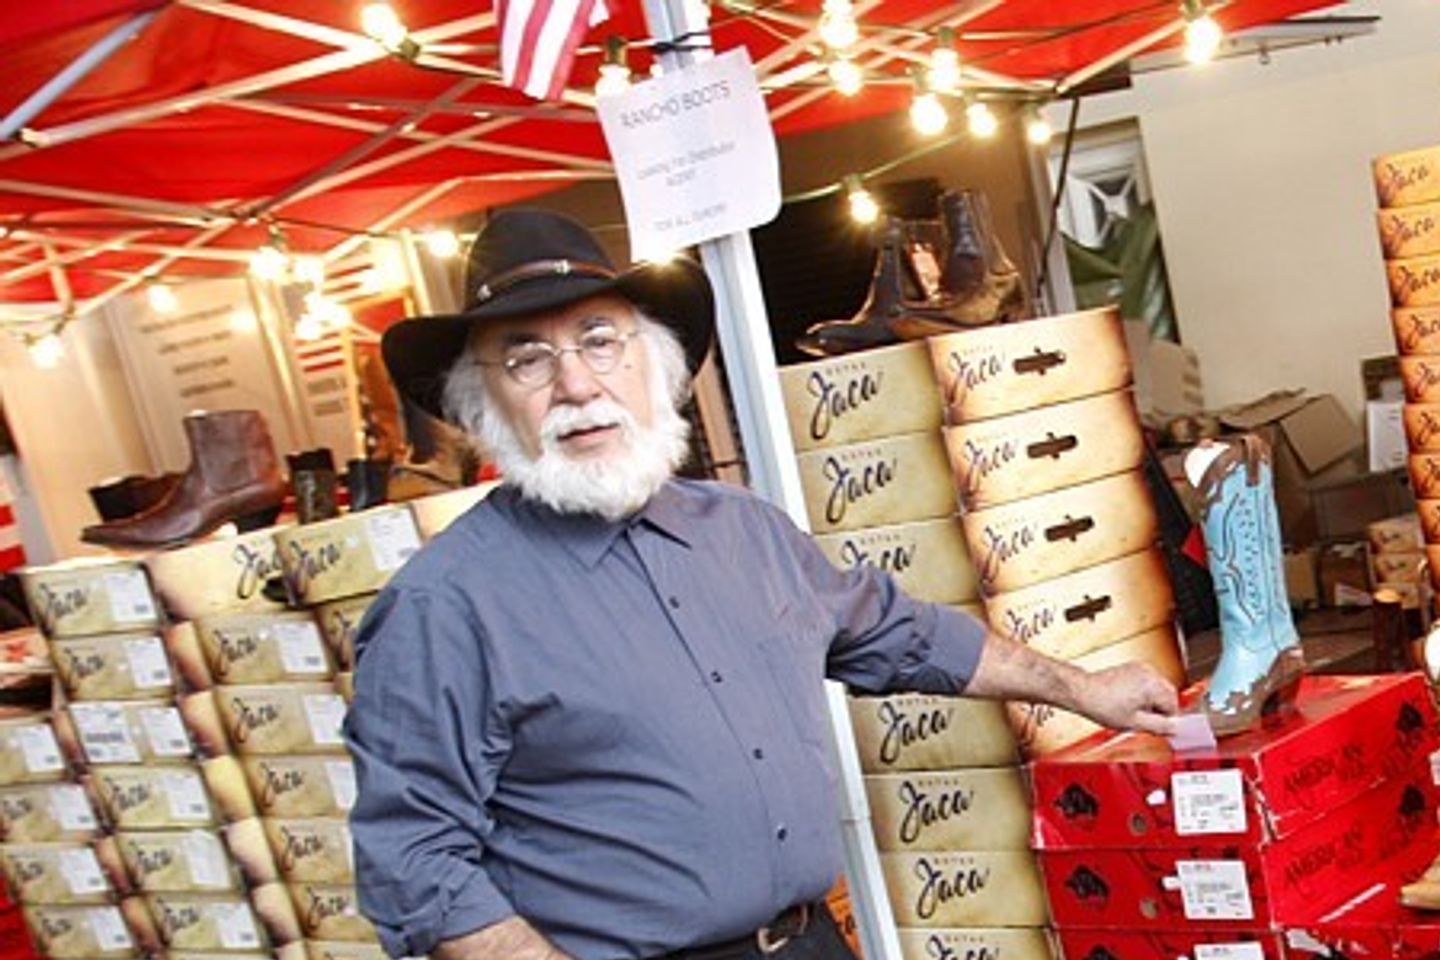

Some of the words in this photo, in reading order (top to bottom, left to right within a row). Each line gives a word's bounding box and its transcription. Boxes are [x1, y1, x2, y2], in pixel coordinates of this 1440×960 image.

[620, 99, 680, 129] RANCHO
[683, 80, 731, 111] BOOTS
[807, 371, 884, 440] Jaca
[824, 456, 899, 524] Jaca
[879, 699, 956, 764] Jaca
[899, 780, 975, 843] Jaca
[914, 857, 991, 921] Jaca
